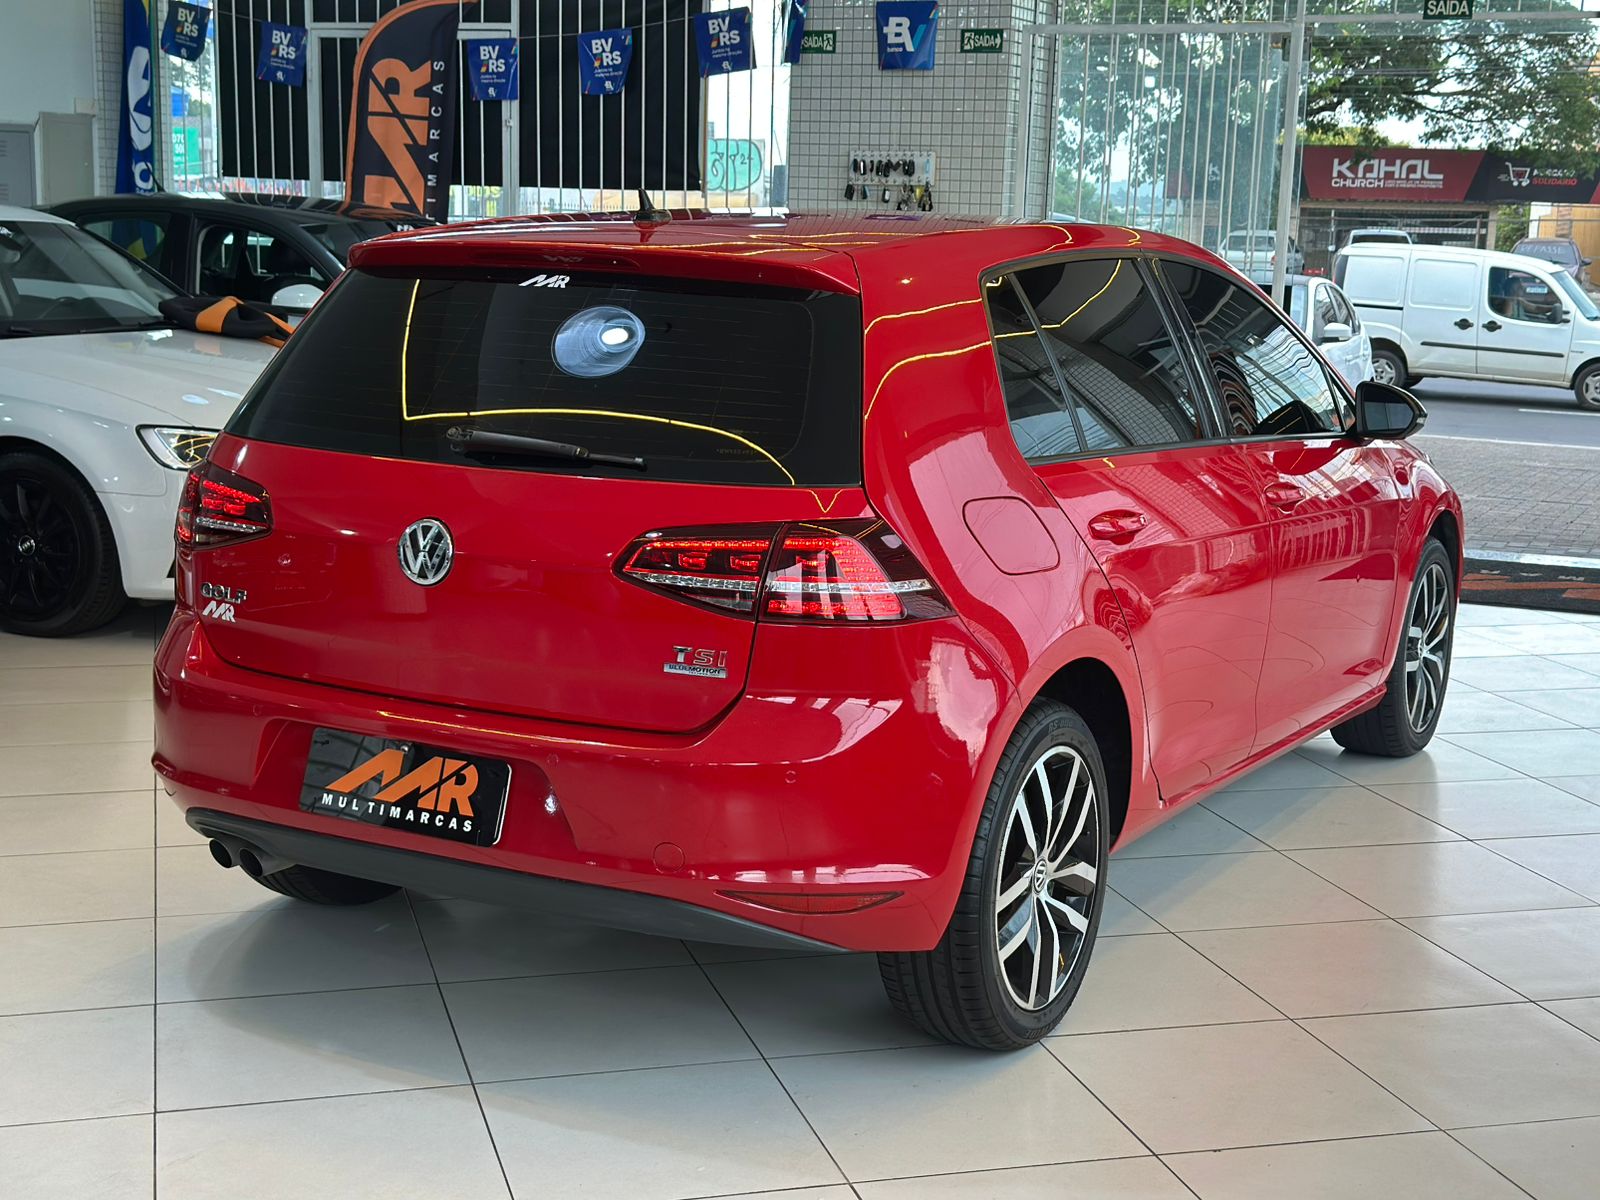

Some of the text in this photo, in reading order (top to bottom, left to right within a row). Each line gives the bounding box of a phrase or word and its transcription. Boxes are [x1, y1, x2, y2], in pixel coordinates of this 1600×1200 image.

[177, 8, 196, 23] BV
[183, 22, 199, 37] RS
[708, 15, 730, 35] BV
[272, 30, 291, 45] BV
[719, 30, 740, 46] RS
[975, 32, 996, 48] SAÍDA
[279, 45, 296, 60] RS
[480, 45, 499, 60] BV
[592, 37, 613, 54] BV
[488, 59, 506, 72] RS
[602, 51, 622, 66] RS
[1332, 158, 1444, 180] KAHAL
[1331, 178, 1384, 189] CHURCH
[201, 582, 248, 605] GOLF
[673, 645, 728, 668] TSI
[321, 792, 473, 833] MULTIMARCAS
